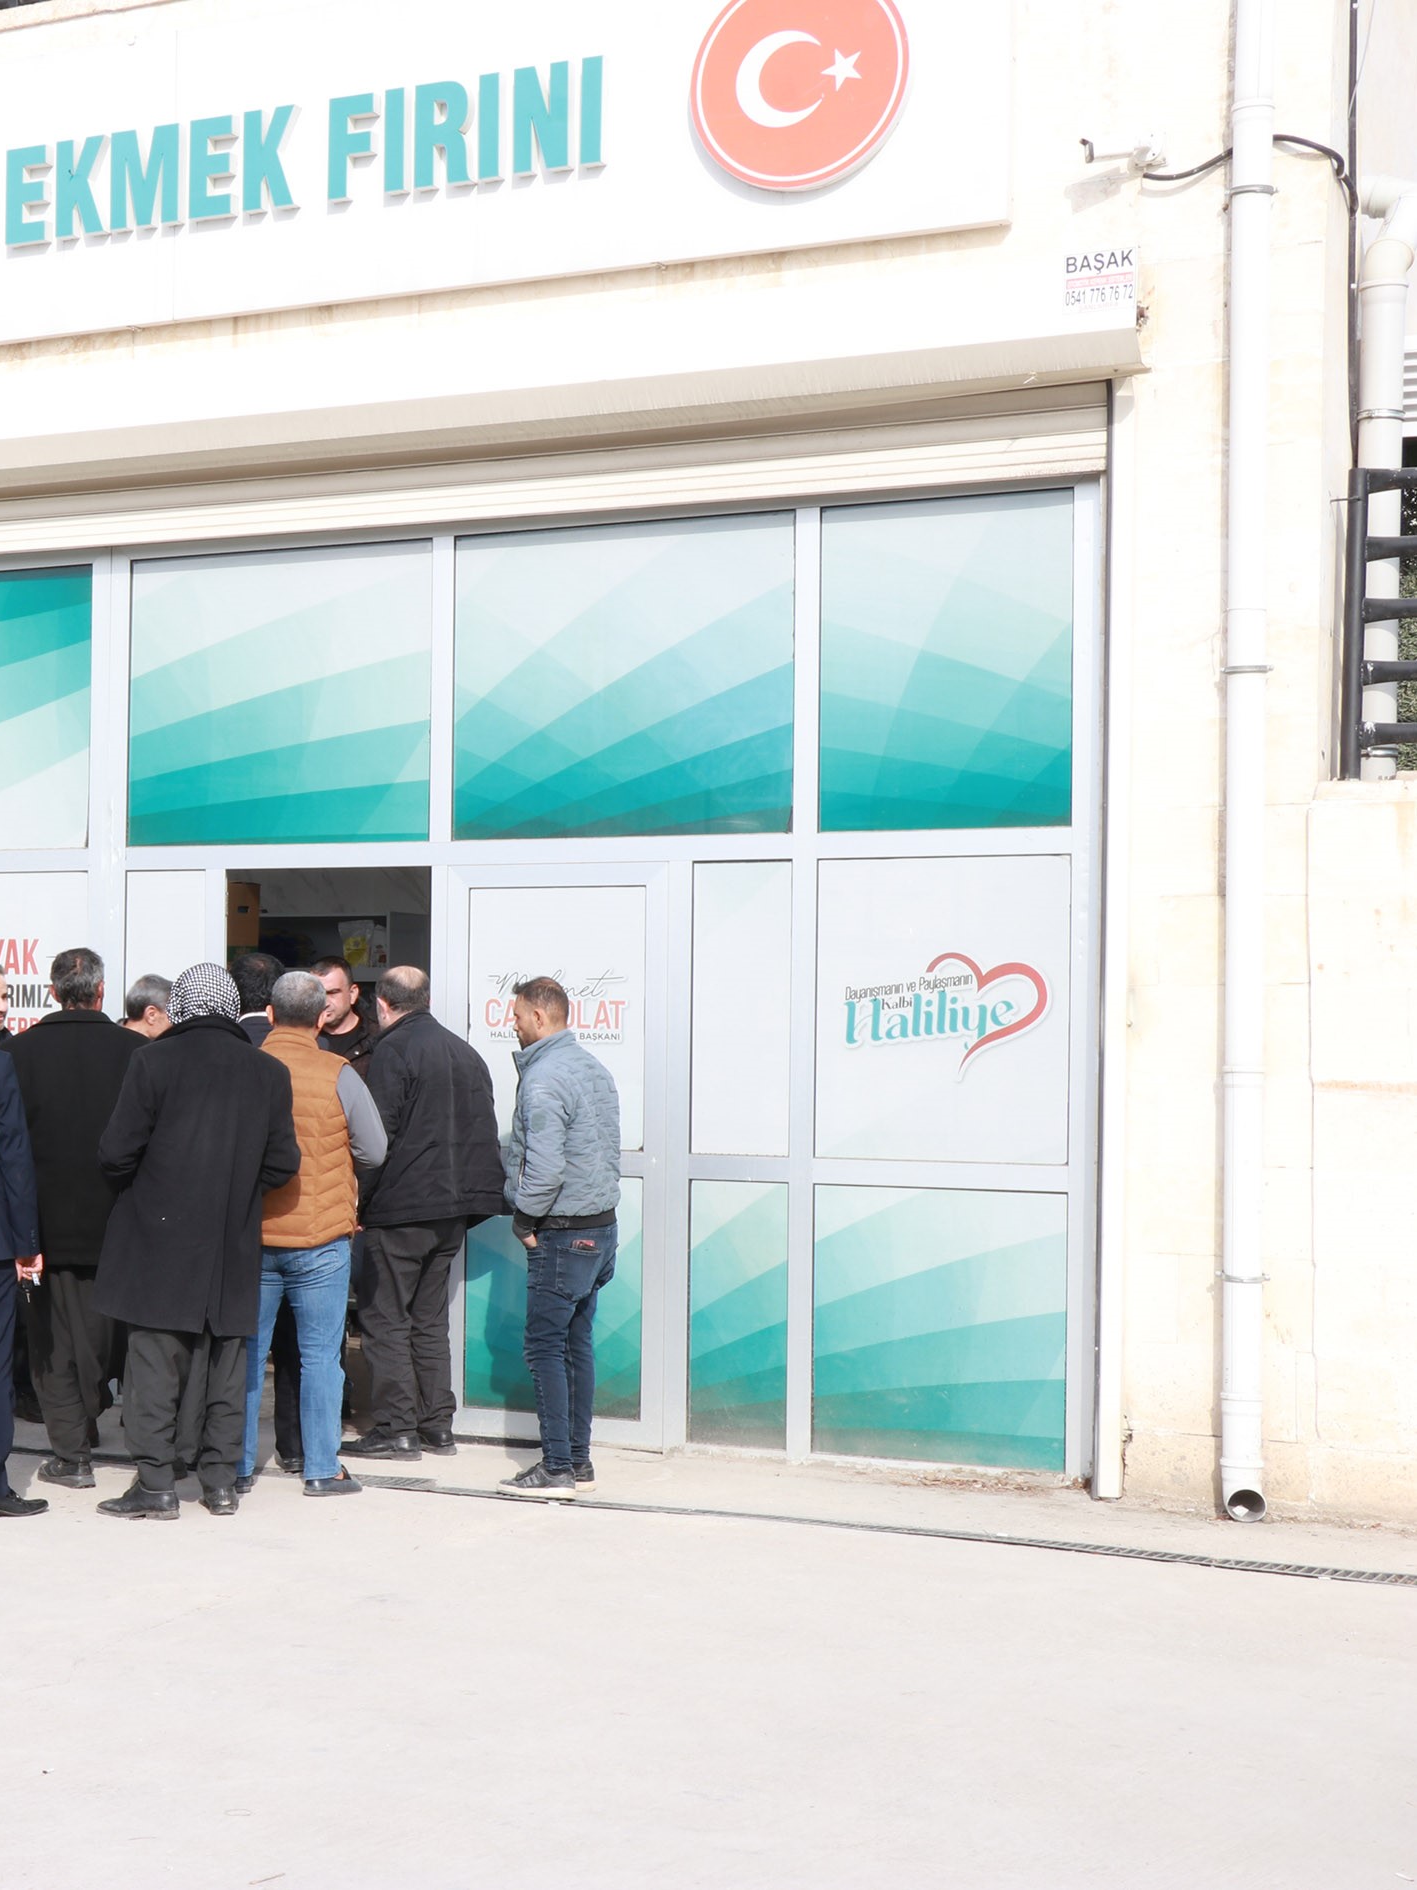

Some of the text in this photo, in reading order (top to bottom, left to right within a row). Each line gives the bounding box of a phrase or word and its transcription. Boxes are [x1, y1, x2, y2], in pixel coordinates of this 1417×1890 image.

[5, 103, 295, 245] EKMEK
[327, 55, 604, 200] FIRINI
[1066, 249, 1133, 274] BAŞAK
[1065, 283, 1133, 306] 0541 776 76 72
[906, 981, 917, 993] ve
[881, 996, 913, 1010] Kalbi
[843, 990, 1014, 1050] Haliliye
[579, 1032, 620, 1041] BAŞKANI
